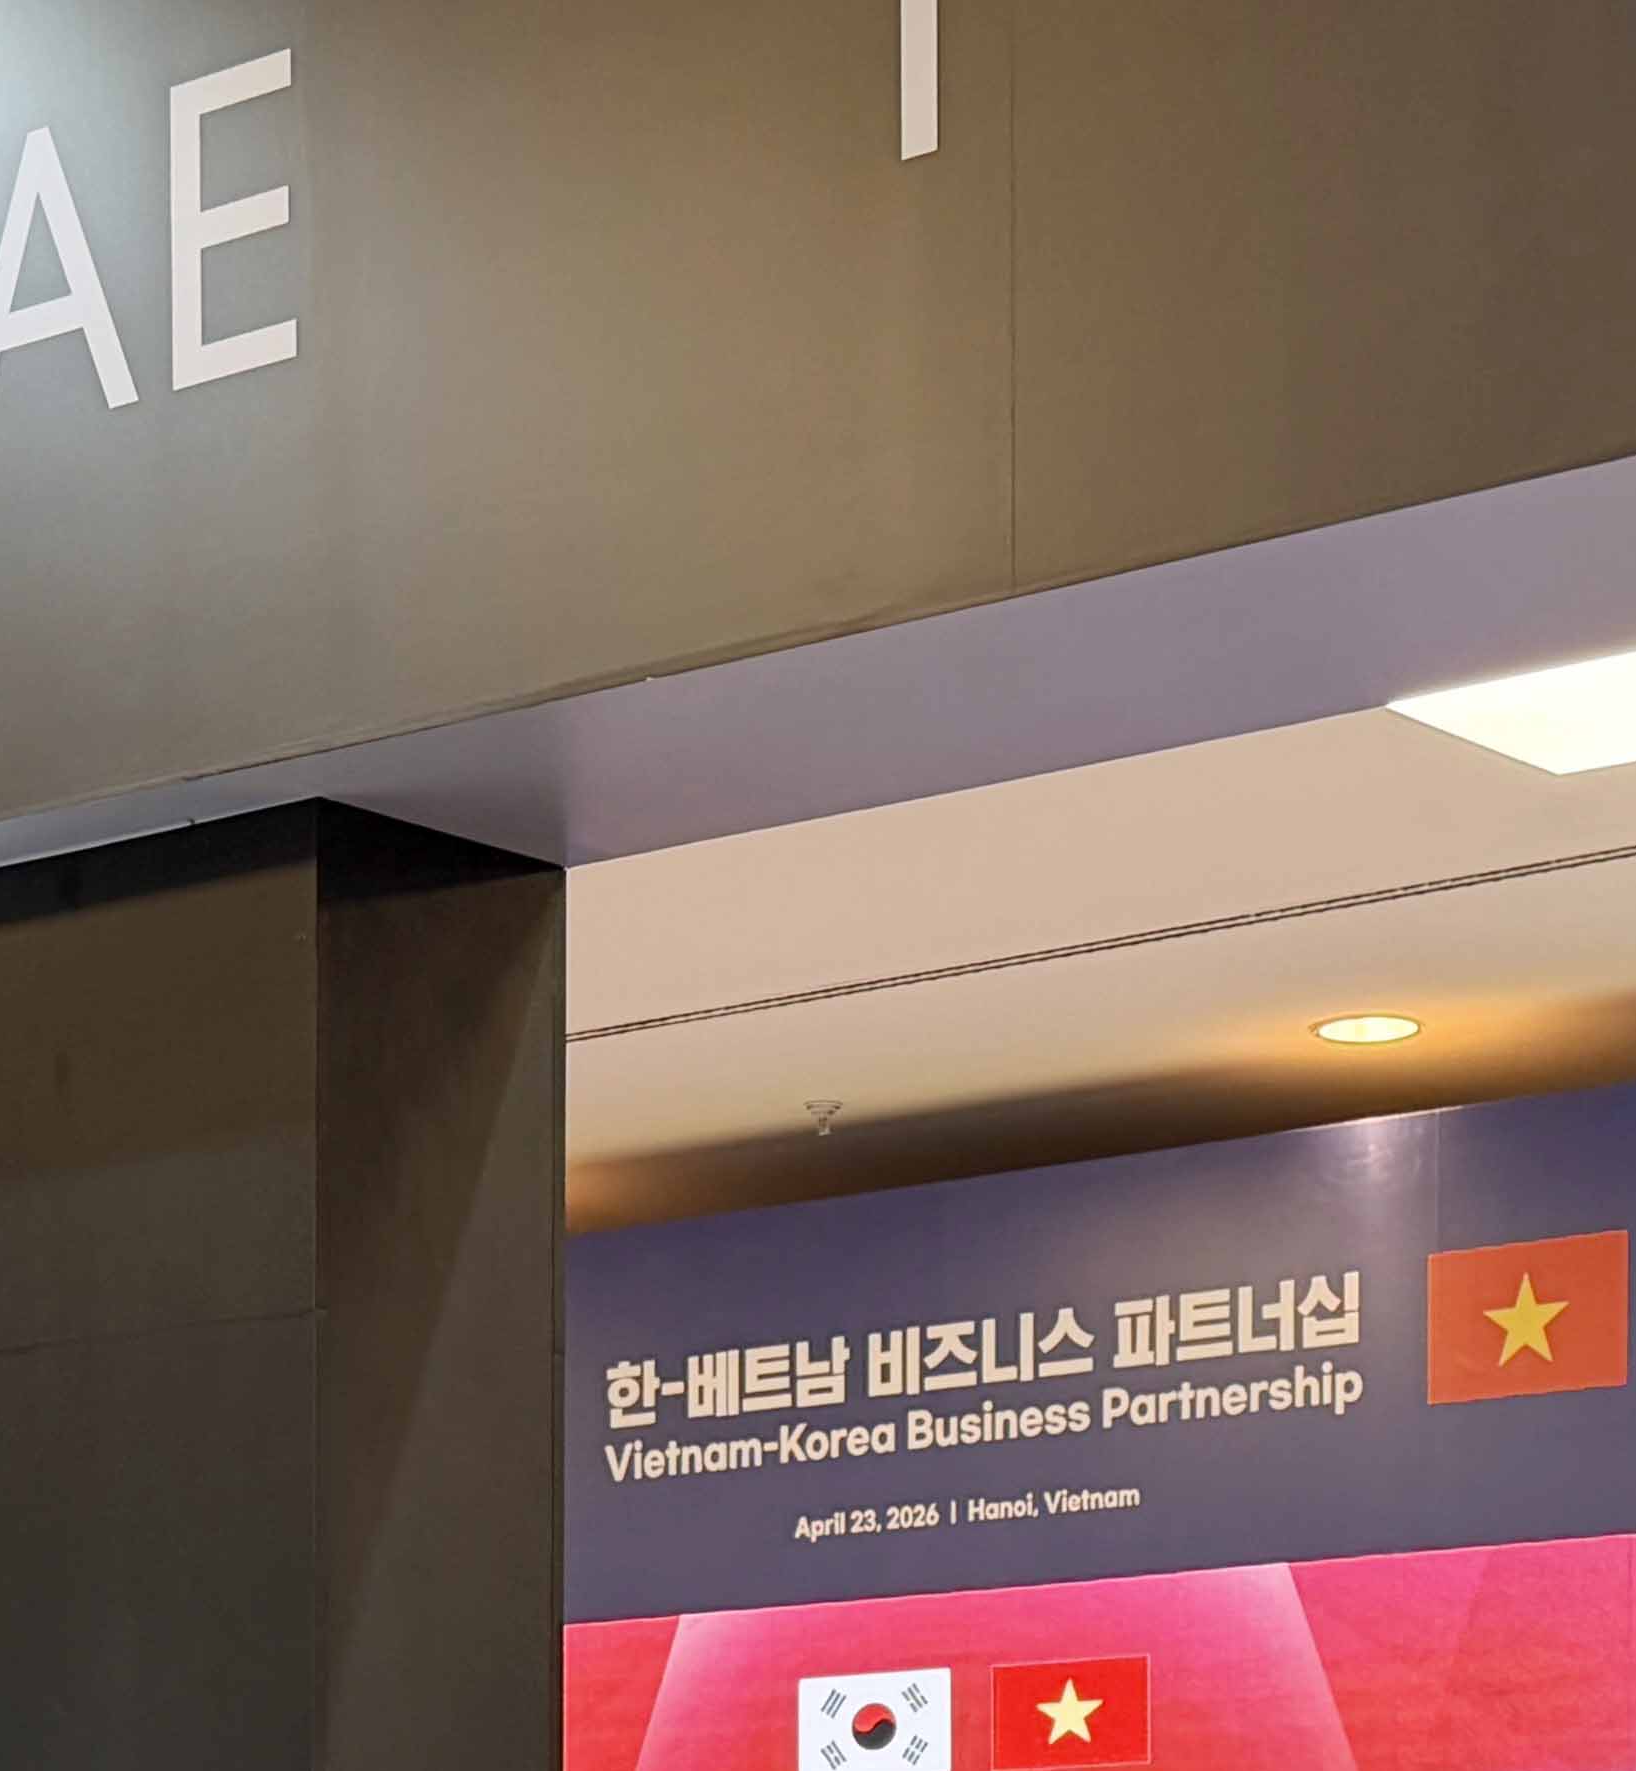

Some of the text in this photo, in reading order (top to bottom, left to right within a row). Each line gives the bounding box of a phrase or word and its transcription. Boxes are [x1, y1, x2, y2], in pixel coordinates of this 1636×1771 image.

[606, 1270, 1360, 1430] 한-베트남 비즈니스 파트너십
[605, 1360, 1364, 1483] Vietnam-Korea Business Partnership
[794, 1511, 846, 1542] April
[850, 1509, 883, 1534] 23,
[886, 1503, 940, 1530] 2026
[967, 1493, 1040, 1523] Hanoi,
[1044, 1487, 1141, 1515] Vietnam
